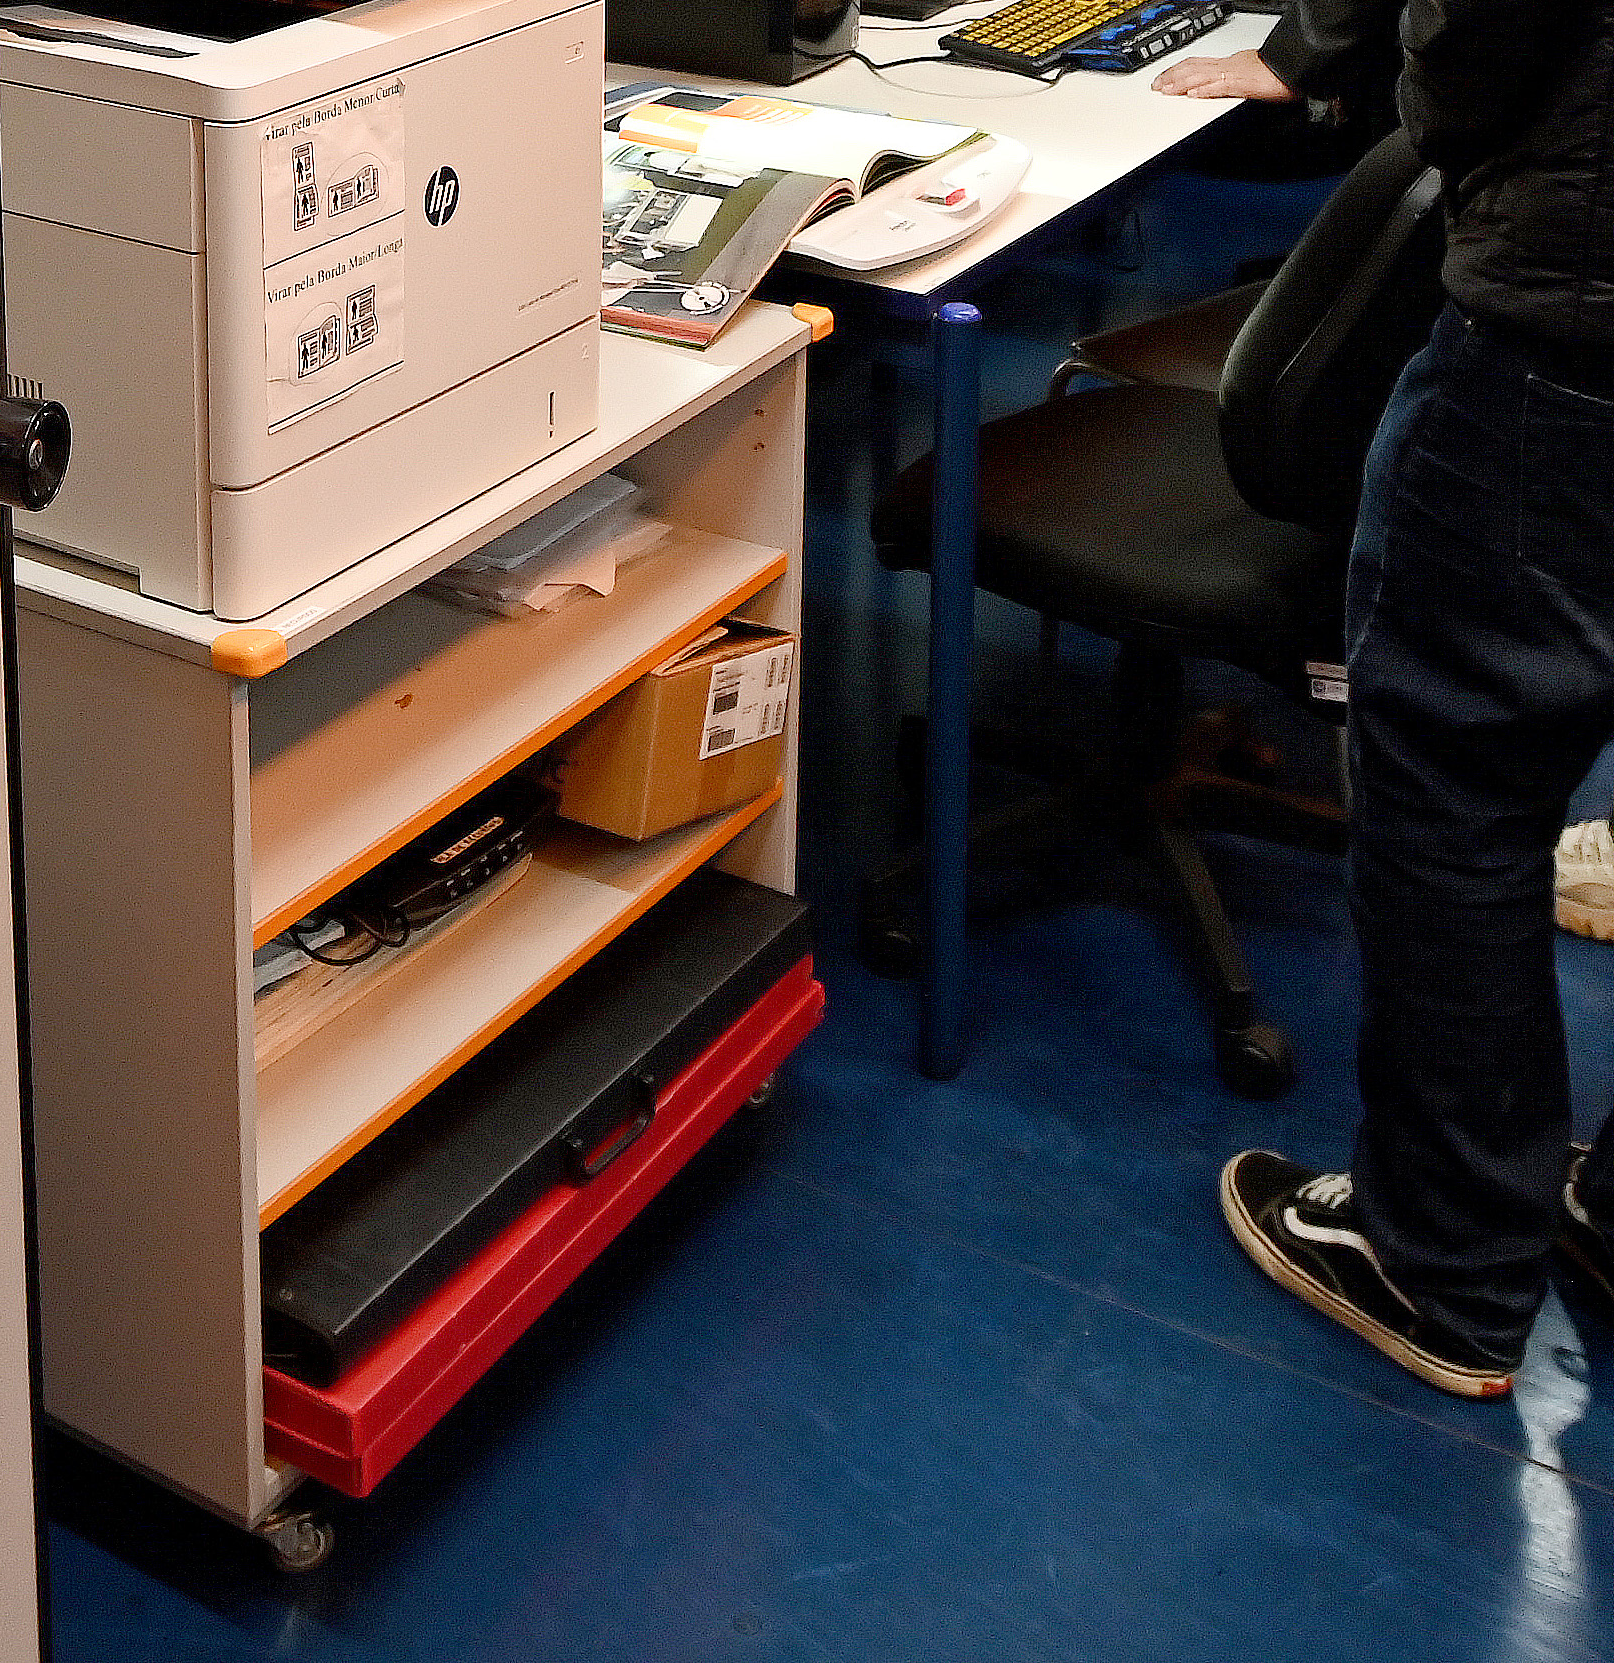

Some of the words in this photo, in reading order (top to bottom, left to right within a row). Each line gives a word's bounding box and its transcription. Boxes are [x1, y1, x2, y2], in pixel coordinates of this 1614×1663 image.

[292, 115, 311, 136] pela
[315, 103, 342, 124] Borda
[426, 166, 458, 226] hp
[268, 287, 291, 304] Virar
[294, 274, 315, 297] pela
[317, 262, 346, 283] Borda
